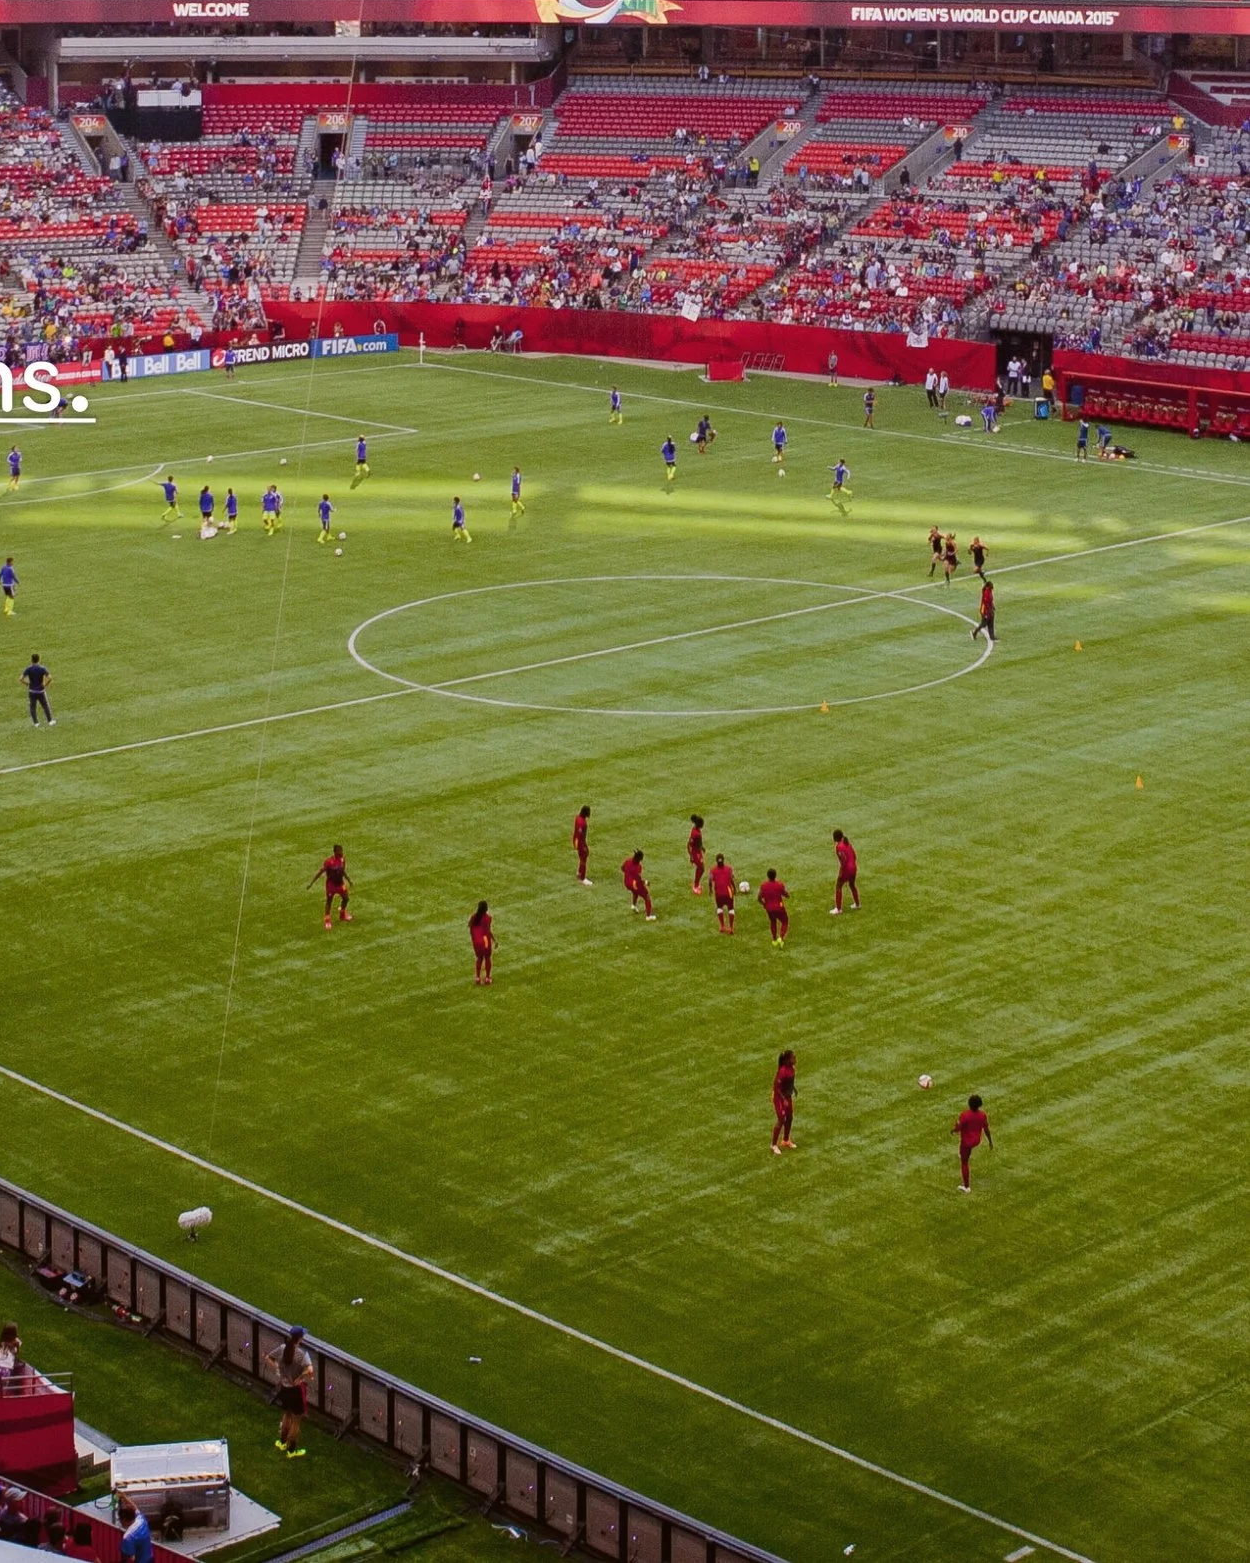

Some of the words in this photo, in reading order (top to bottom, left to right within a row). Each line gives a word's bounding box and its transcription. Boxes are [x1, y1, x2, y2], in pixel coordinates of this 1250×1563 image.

[173, 2, 250, 17] WELCOME
[851, 7, 883, 21] FIFA
[883, 8, 949, 22] WOMEN'S
[950, 8, 1000, 23] WORLD
[1001, 9, 1029, 24] CUP
[1029, 10, 1085, 25] CANADA
[79, 117, 98, 128] 204
[325, 114, 345, 125] 206
[520, 116, 538, 127] 207
[272, 342, 310, 359] MICRO
[144, 354, 170, 375] Bell
[176, 351, 201, 371] Bell
